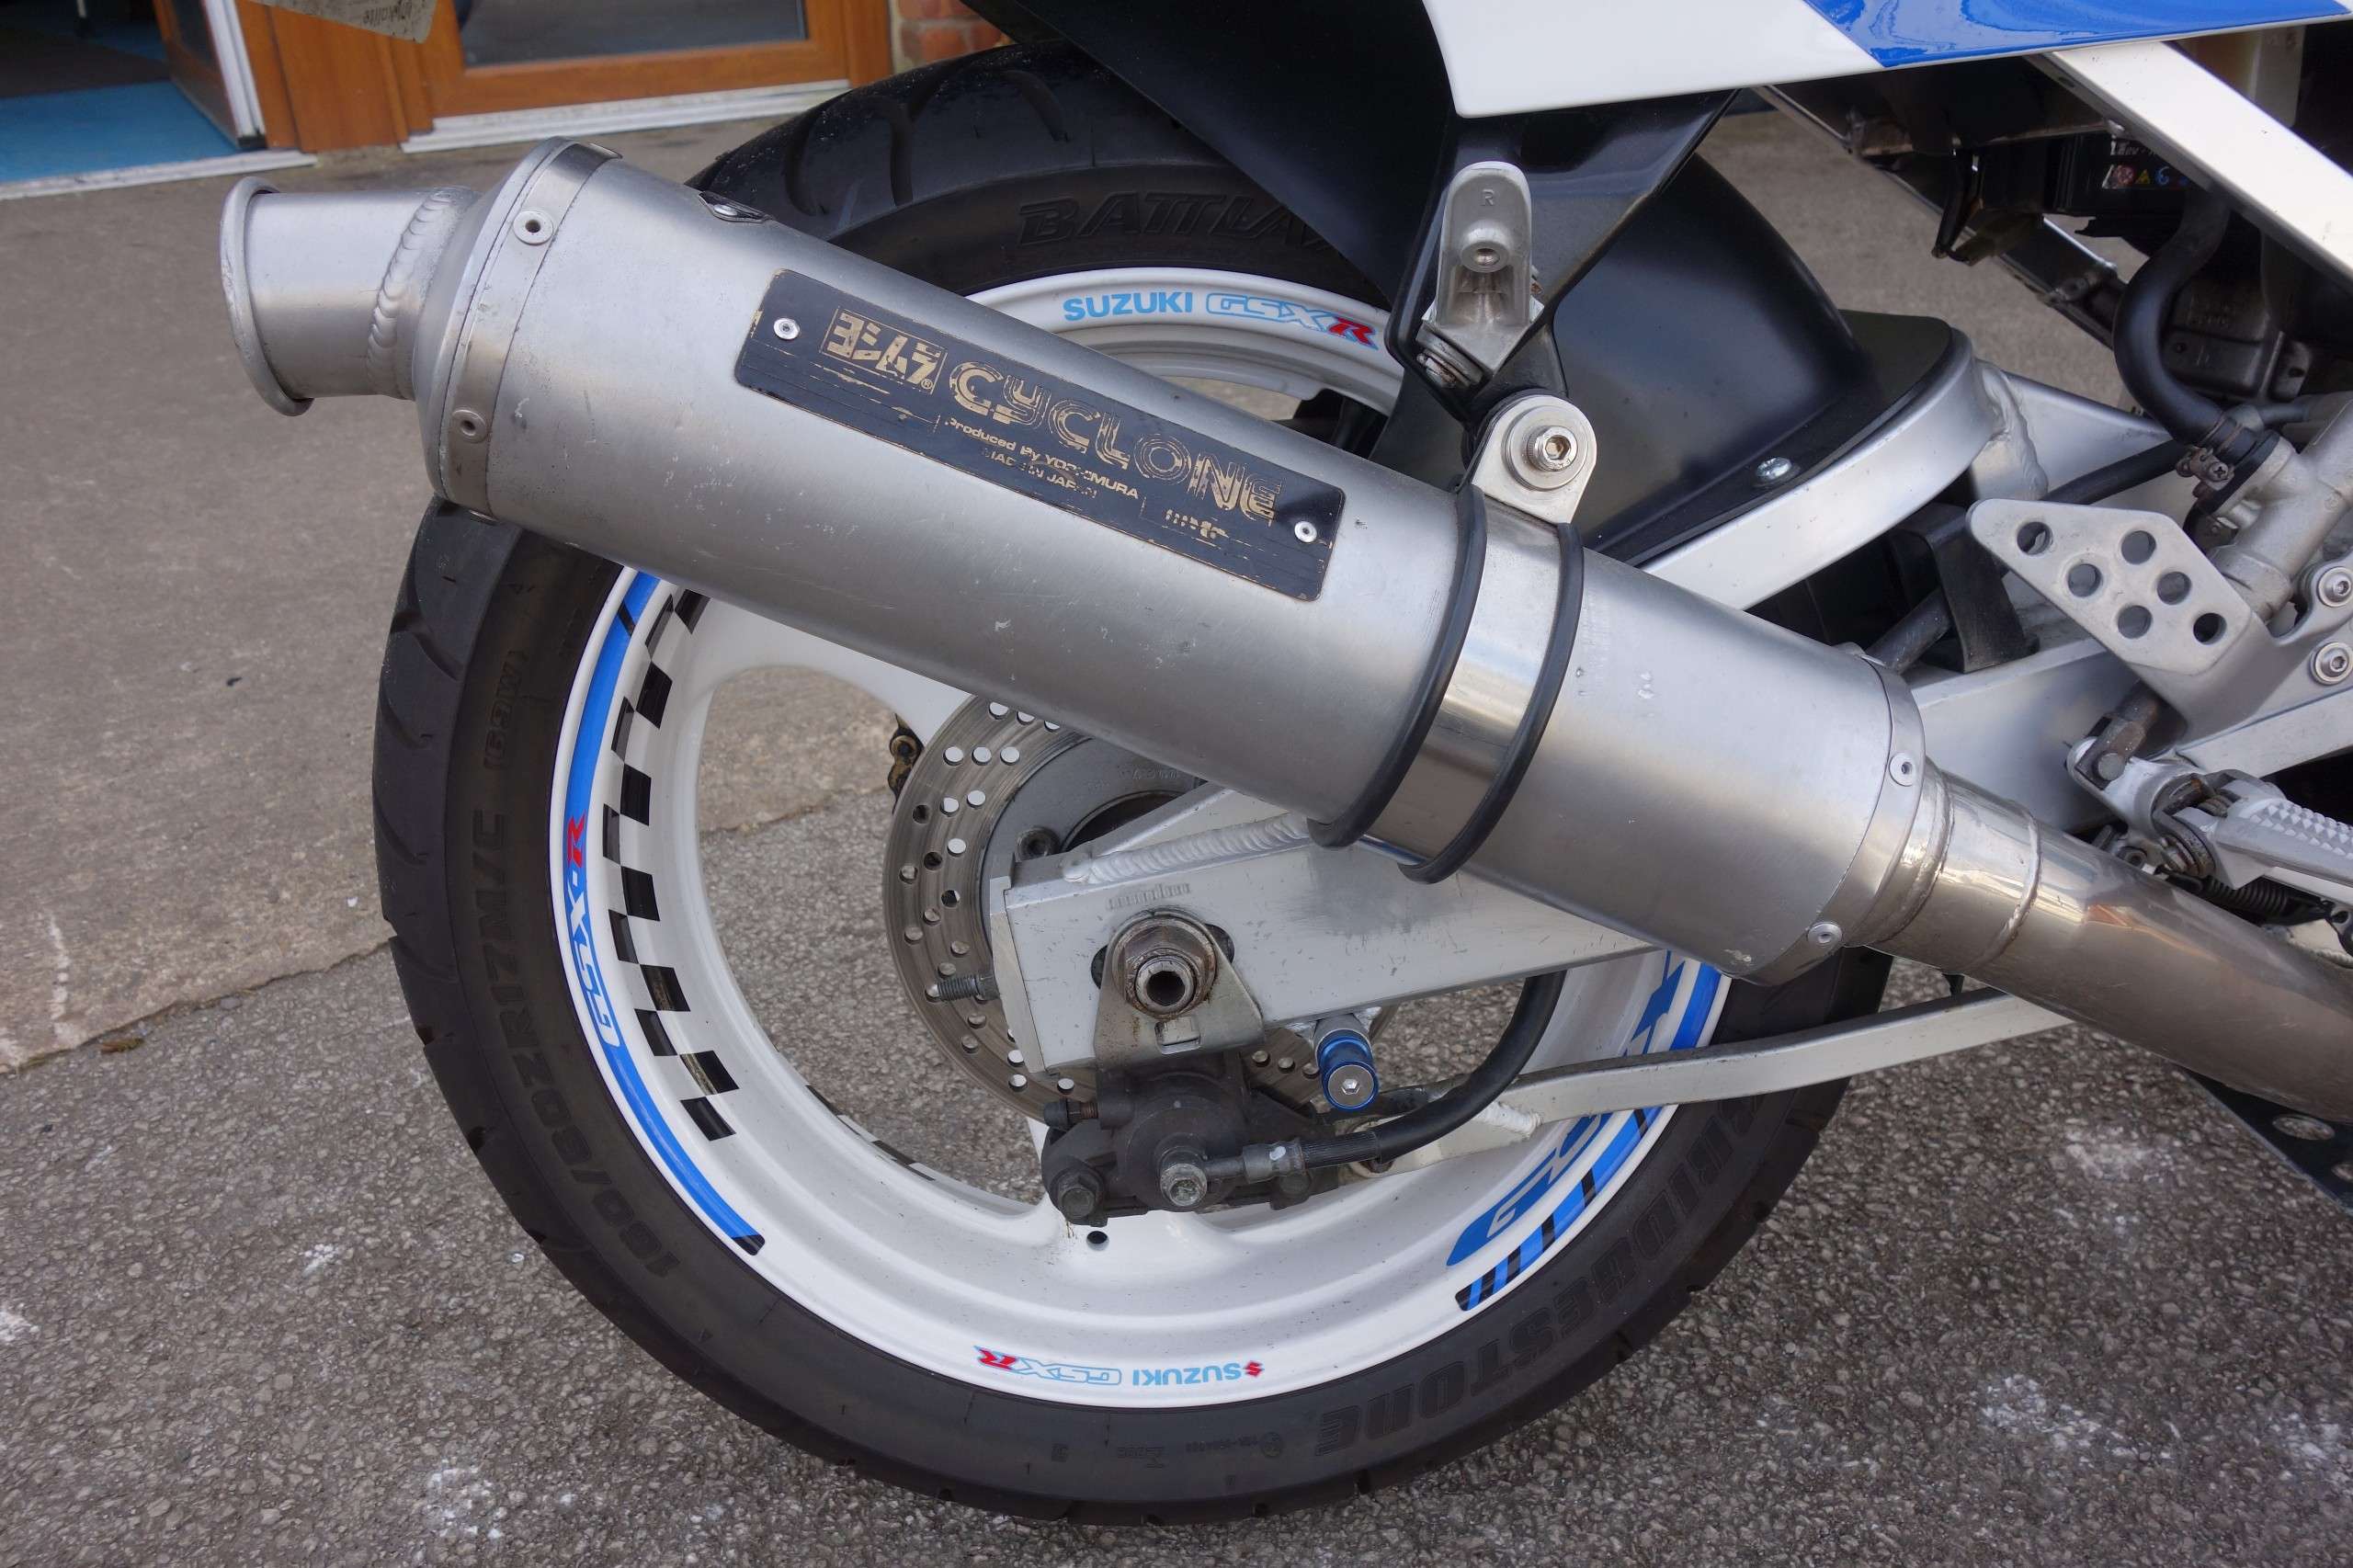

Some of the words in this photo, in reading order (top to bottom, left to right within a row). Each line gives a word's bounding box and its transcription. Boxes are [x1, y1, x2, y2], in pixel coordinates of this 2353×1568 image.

[1017, 190, 1329, 246] BATTLA
[1482, 188, 1495, 207] R
[1063, 291, 1193, 322] SUZUKI
[945, 417, 1017, 451] Produced
[1044, 454, 1140, 500] YOSMURA
[1314, 1094, 1759, 1458] BRIDGESTONE
[1132, 1362, 1242, 1386] SUZUKI
